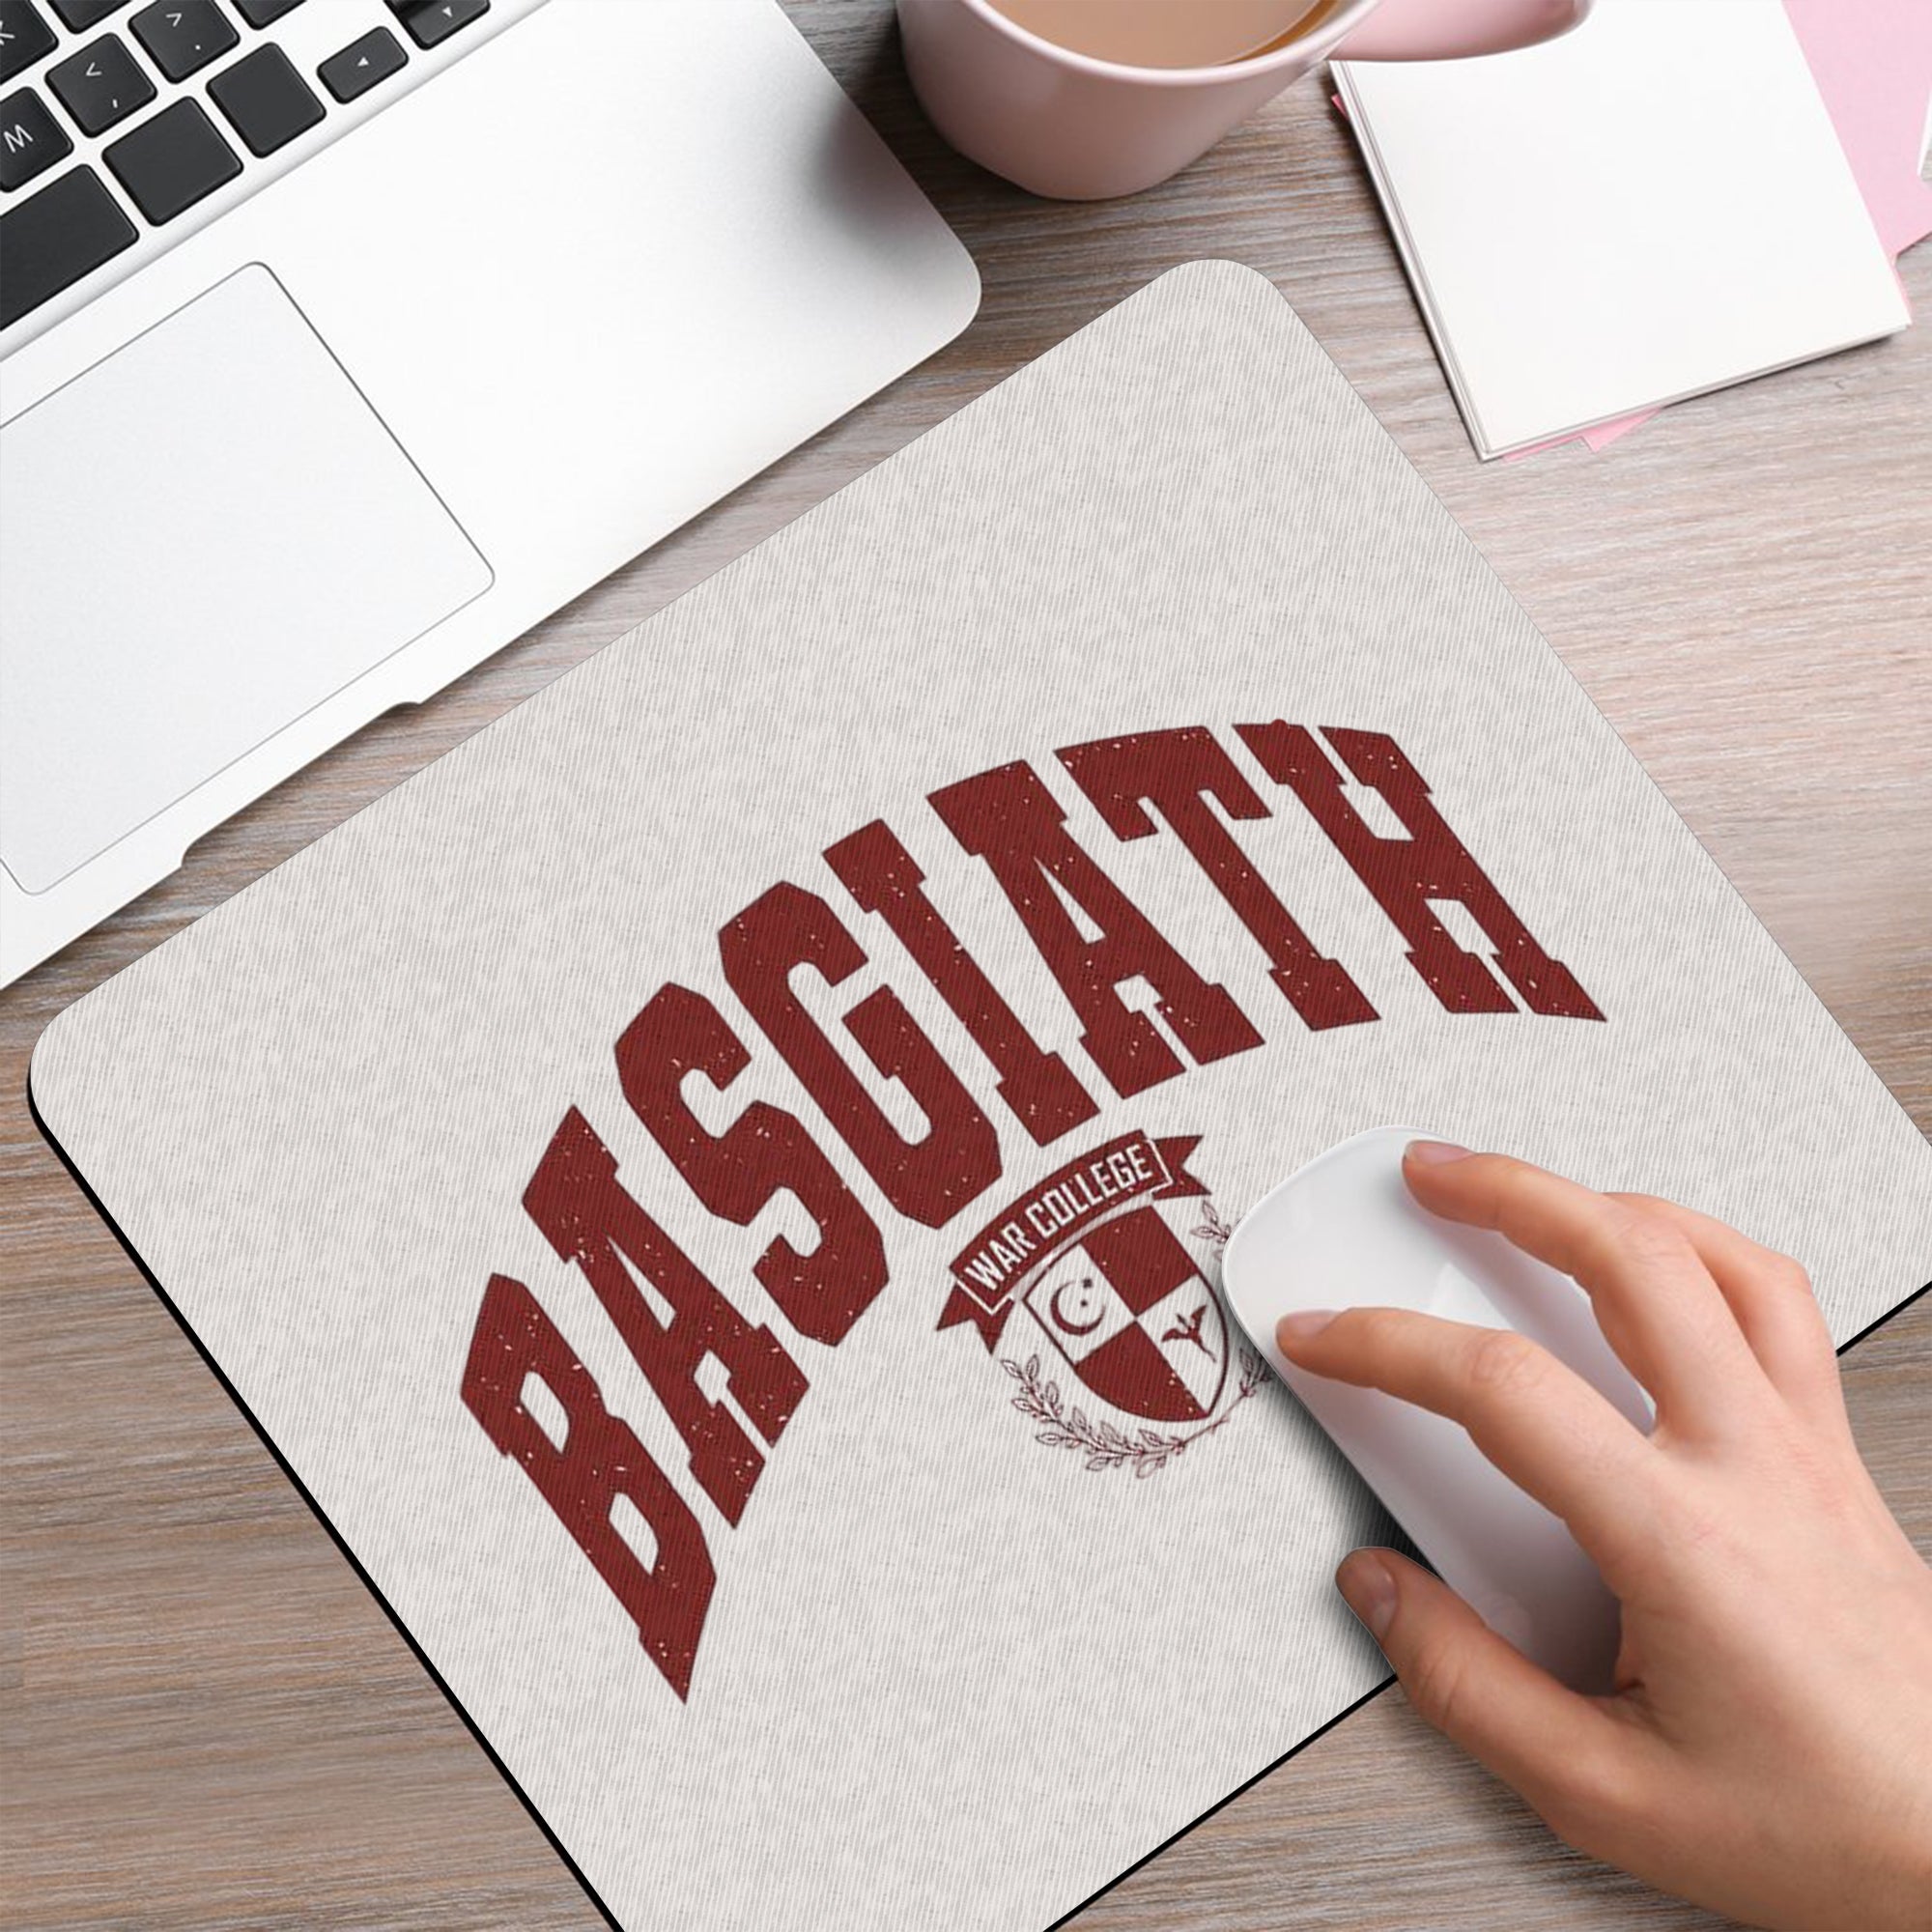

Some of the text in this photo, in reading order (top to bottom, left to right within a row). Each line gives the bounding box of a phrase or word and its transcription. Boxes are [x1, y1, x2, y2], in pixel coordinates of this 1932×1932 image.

[3, 124, 34, 154] M
[461, 719, 1606, 1704] BASGIATH
[964, 1143, 1153, 1292] WAR COLLEGE
